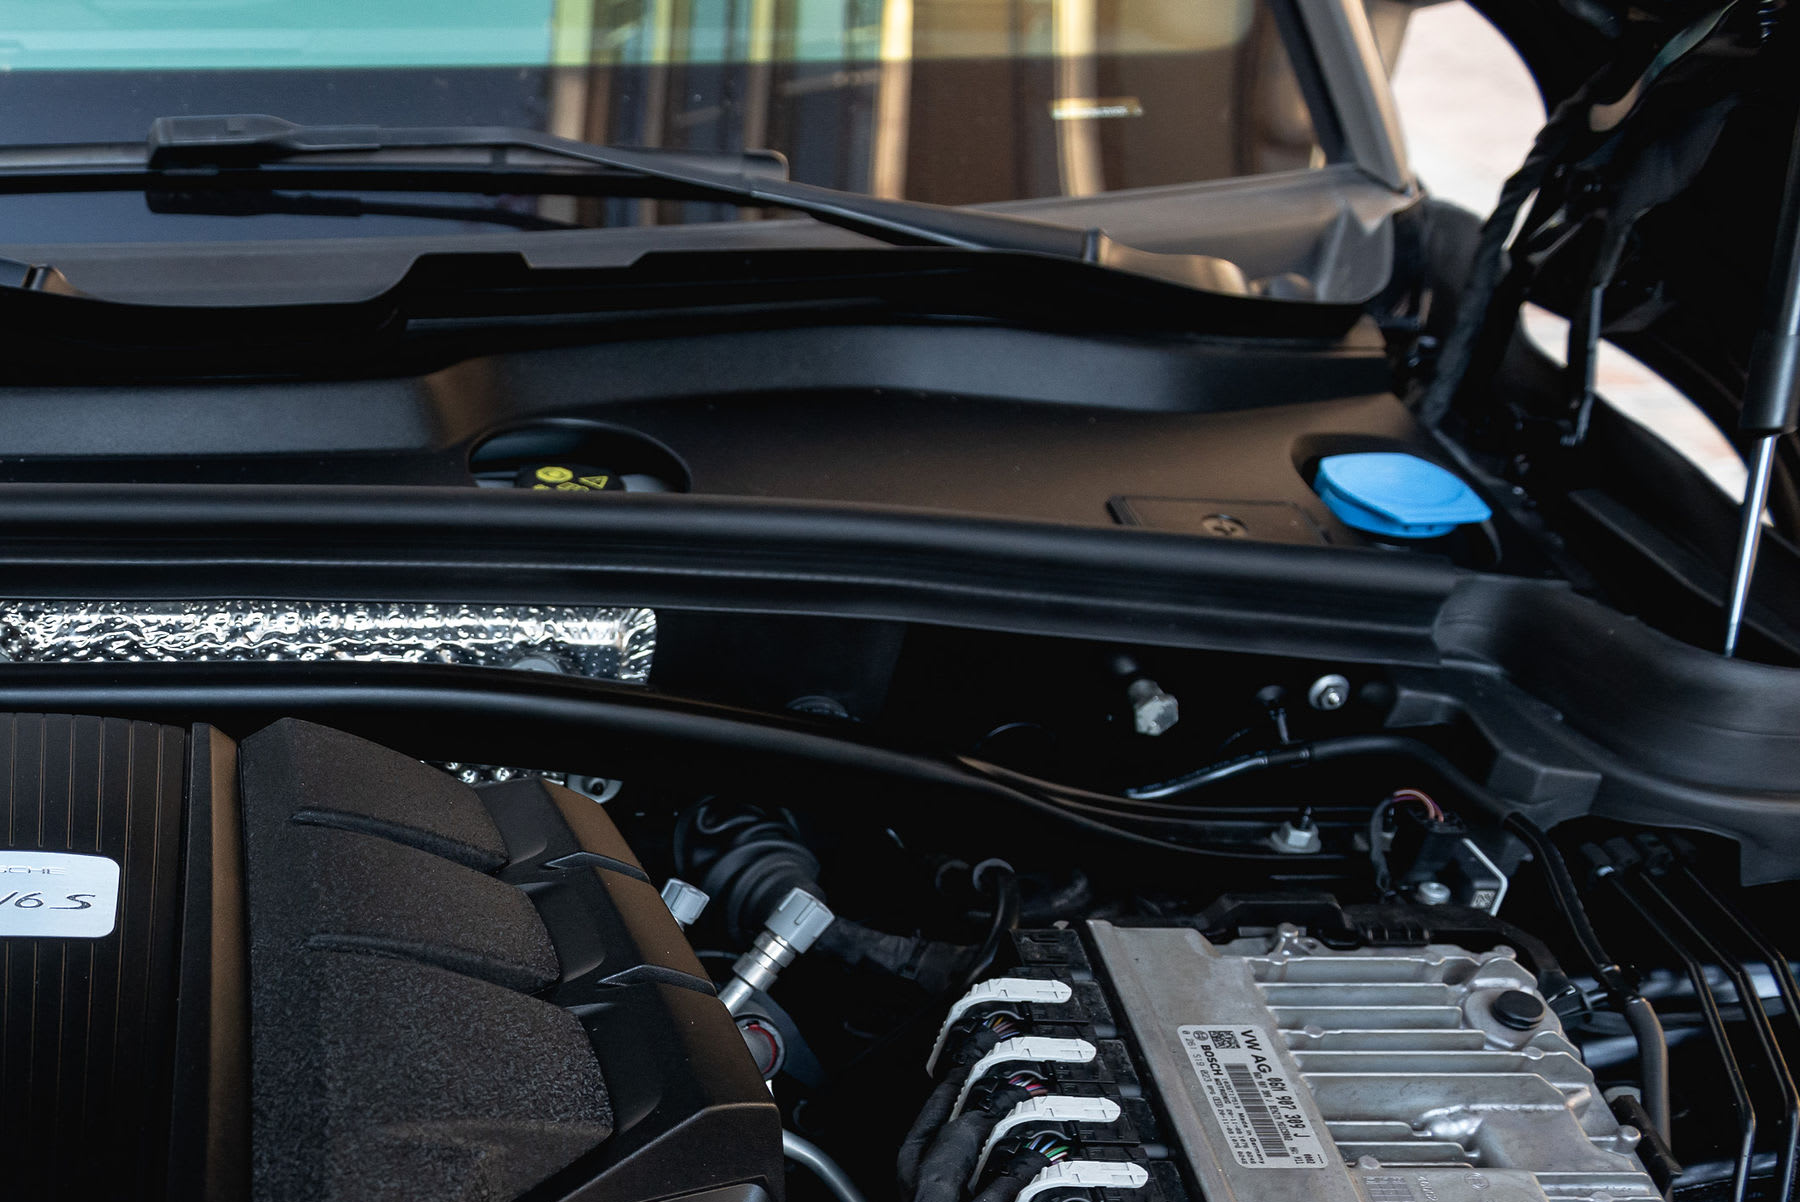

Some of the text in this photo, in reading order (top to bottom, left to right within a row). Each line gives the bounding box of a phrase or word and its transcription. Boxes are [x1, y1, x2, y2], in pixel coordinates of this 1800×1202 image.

[49, 894, 96, 910] S
[1201, 1045, 1223, 1075] BOSCH
[1240, 1029, 1262, 1051] VW
[1251, 1054, 1273, 1073] AG
[1238, 1113, 1249, 1128] Made
[1248, 1137, 1265, 1164] Germany
